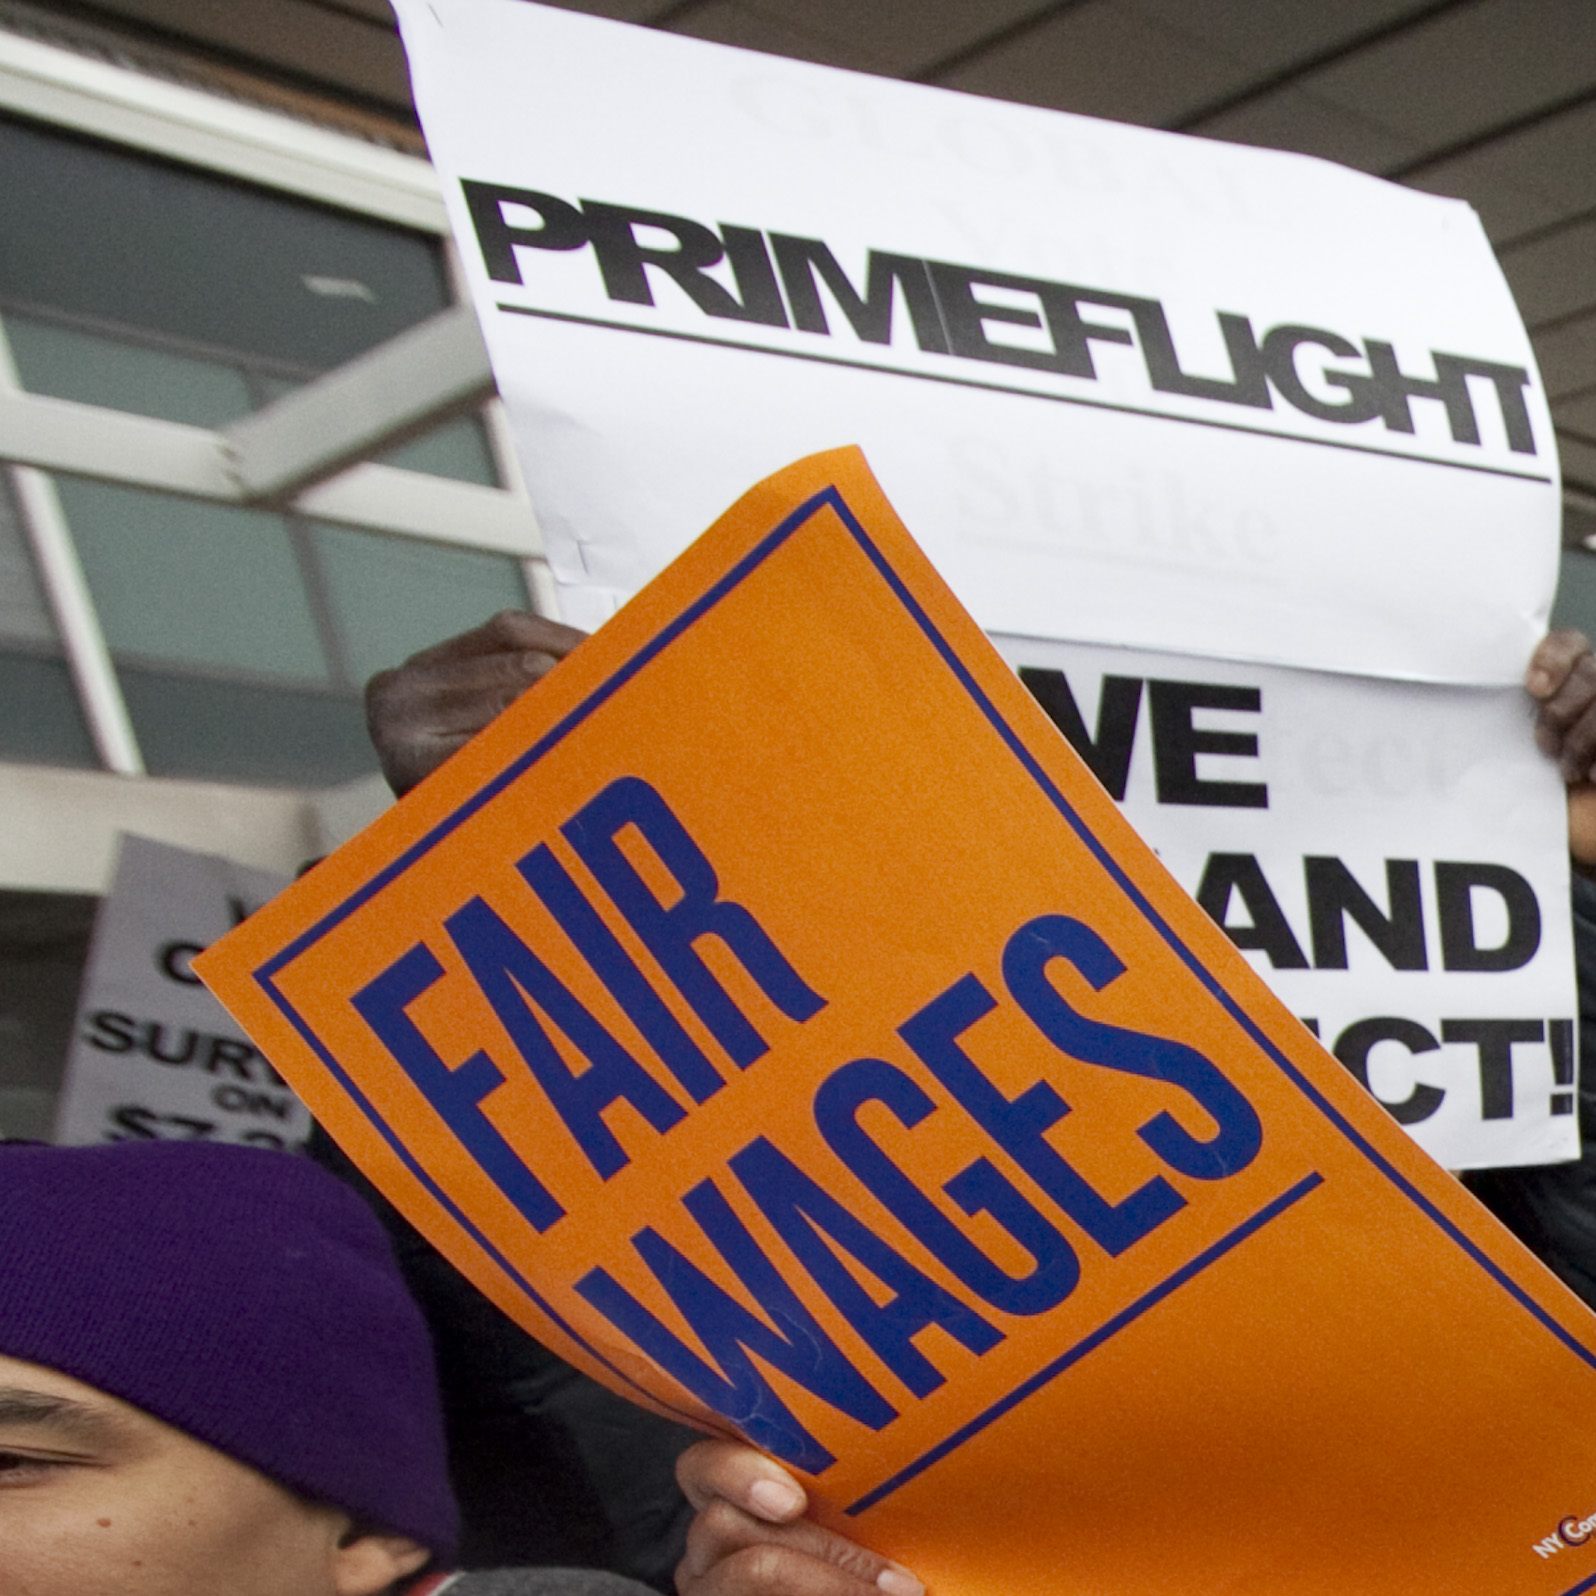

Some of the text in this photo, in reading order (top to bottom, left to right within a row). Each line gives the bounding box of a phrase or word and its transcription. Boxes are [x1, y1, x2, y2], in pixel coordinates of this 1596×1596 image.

[459, 177, 1538, 454] PRIMEFLIGHT
[350, 775, 829, 1235] FAIR
[571, 913, 1264, 1477] WAGES
